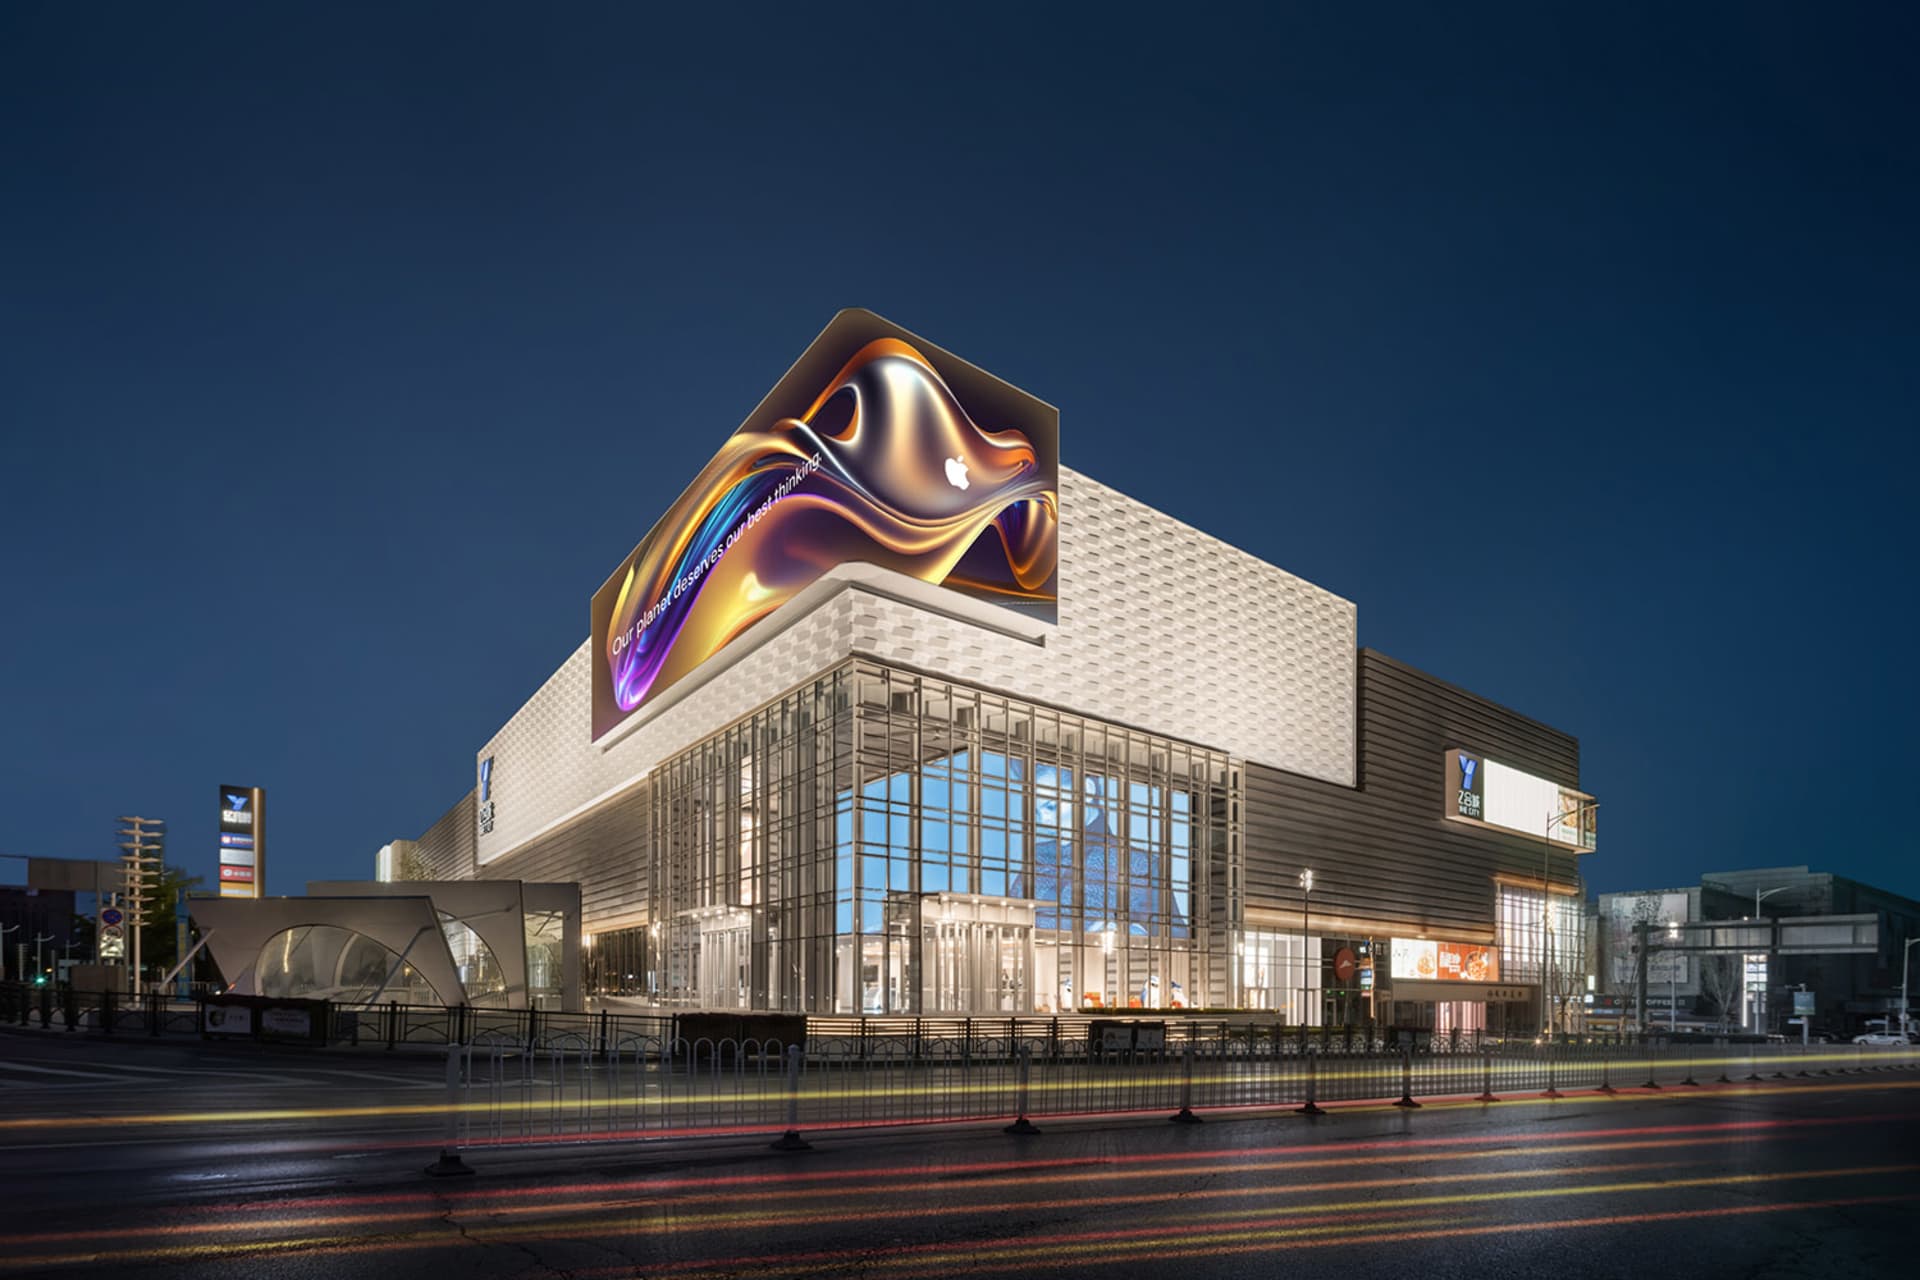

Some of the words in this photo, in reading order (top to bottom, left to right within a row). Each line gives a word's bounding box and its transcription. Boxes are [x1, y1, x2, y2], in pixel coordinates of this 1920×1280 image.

[612, 628, 634, 656] Our
[637, 590, 672, 639] planet
[674, 543, 724, 599] deserves
[726, 522, 746, 548] our
[747, 494, 773, 529] best
[774, 450, 823, 503] thinking.
